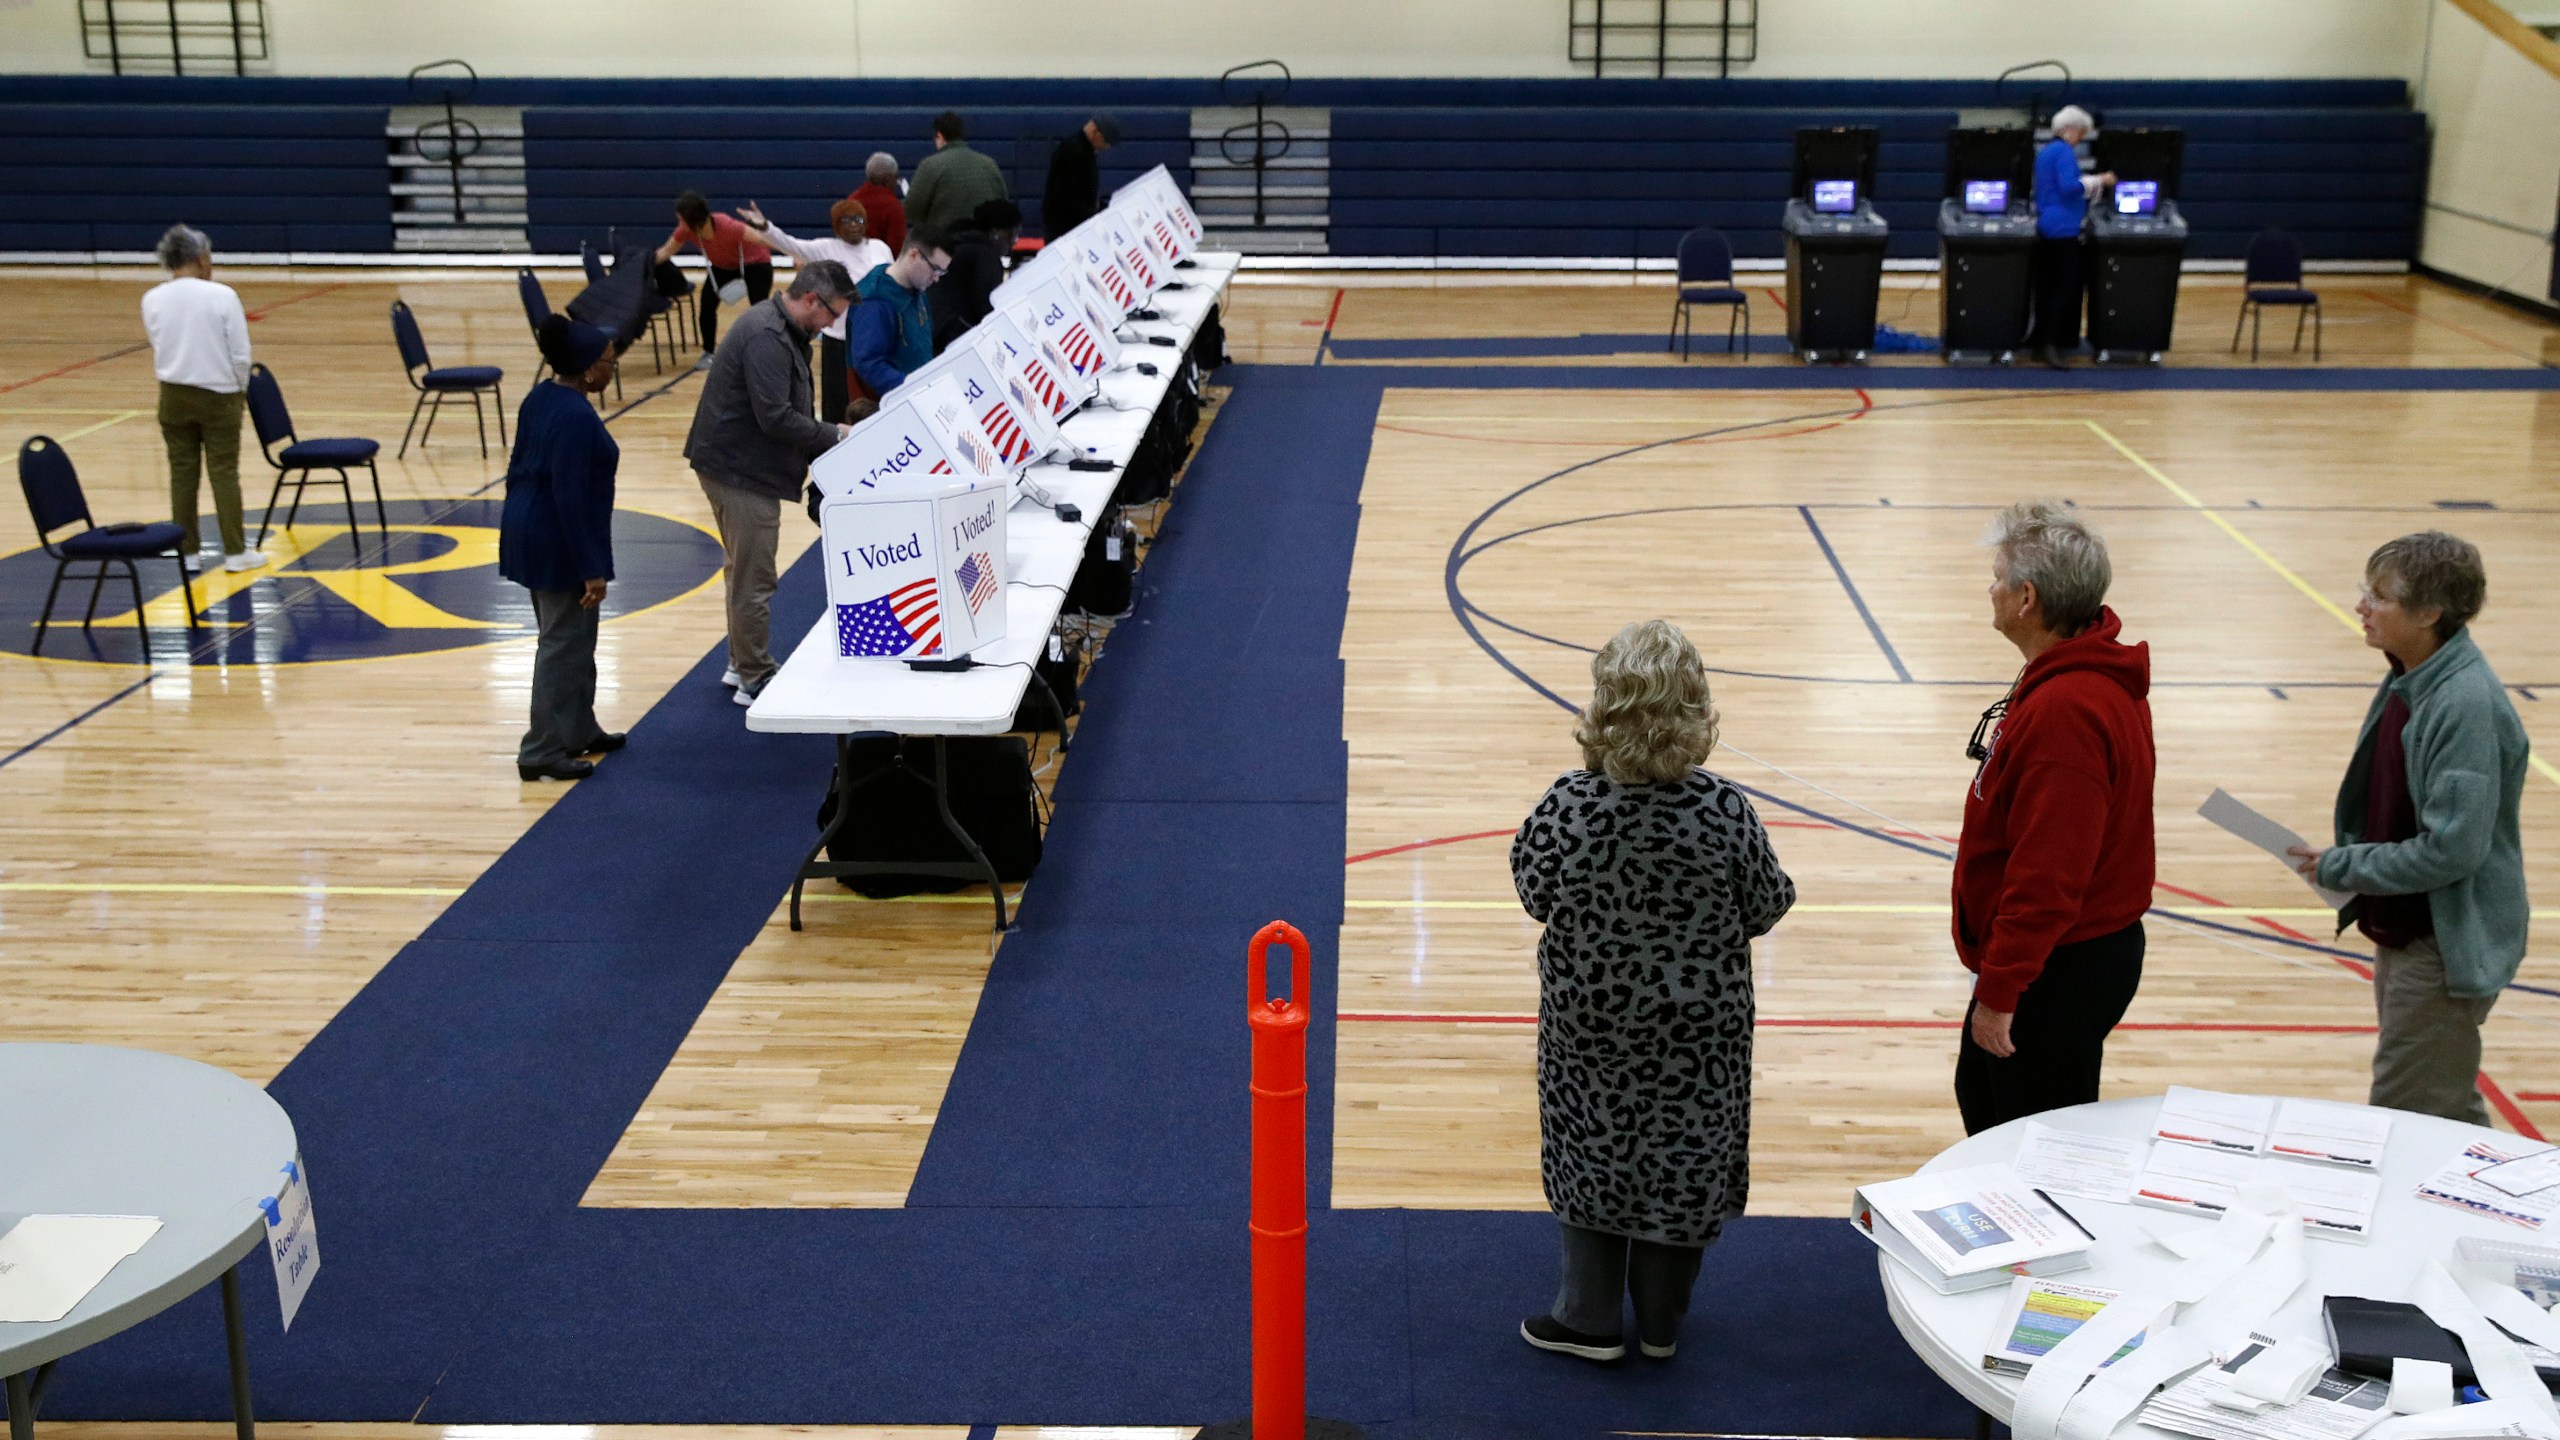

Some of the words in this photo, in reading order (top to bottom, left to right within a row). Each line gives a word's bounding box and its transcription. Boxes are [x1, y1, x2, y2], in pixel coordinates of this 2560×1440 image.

[953, 526, 961, 552] I
[961, 499, 996, 544] Voted!
[30, 524, 524, 629] R
[842, 550, 855, 577] I
[857, 532, 922, 571] Voted
[275, 1195, 311, 1264] Resolution
[1967, 1213, 1995, 1231] USE
[289, 1244, 308, 1286] Table
